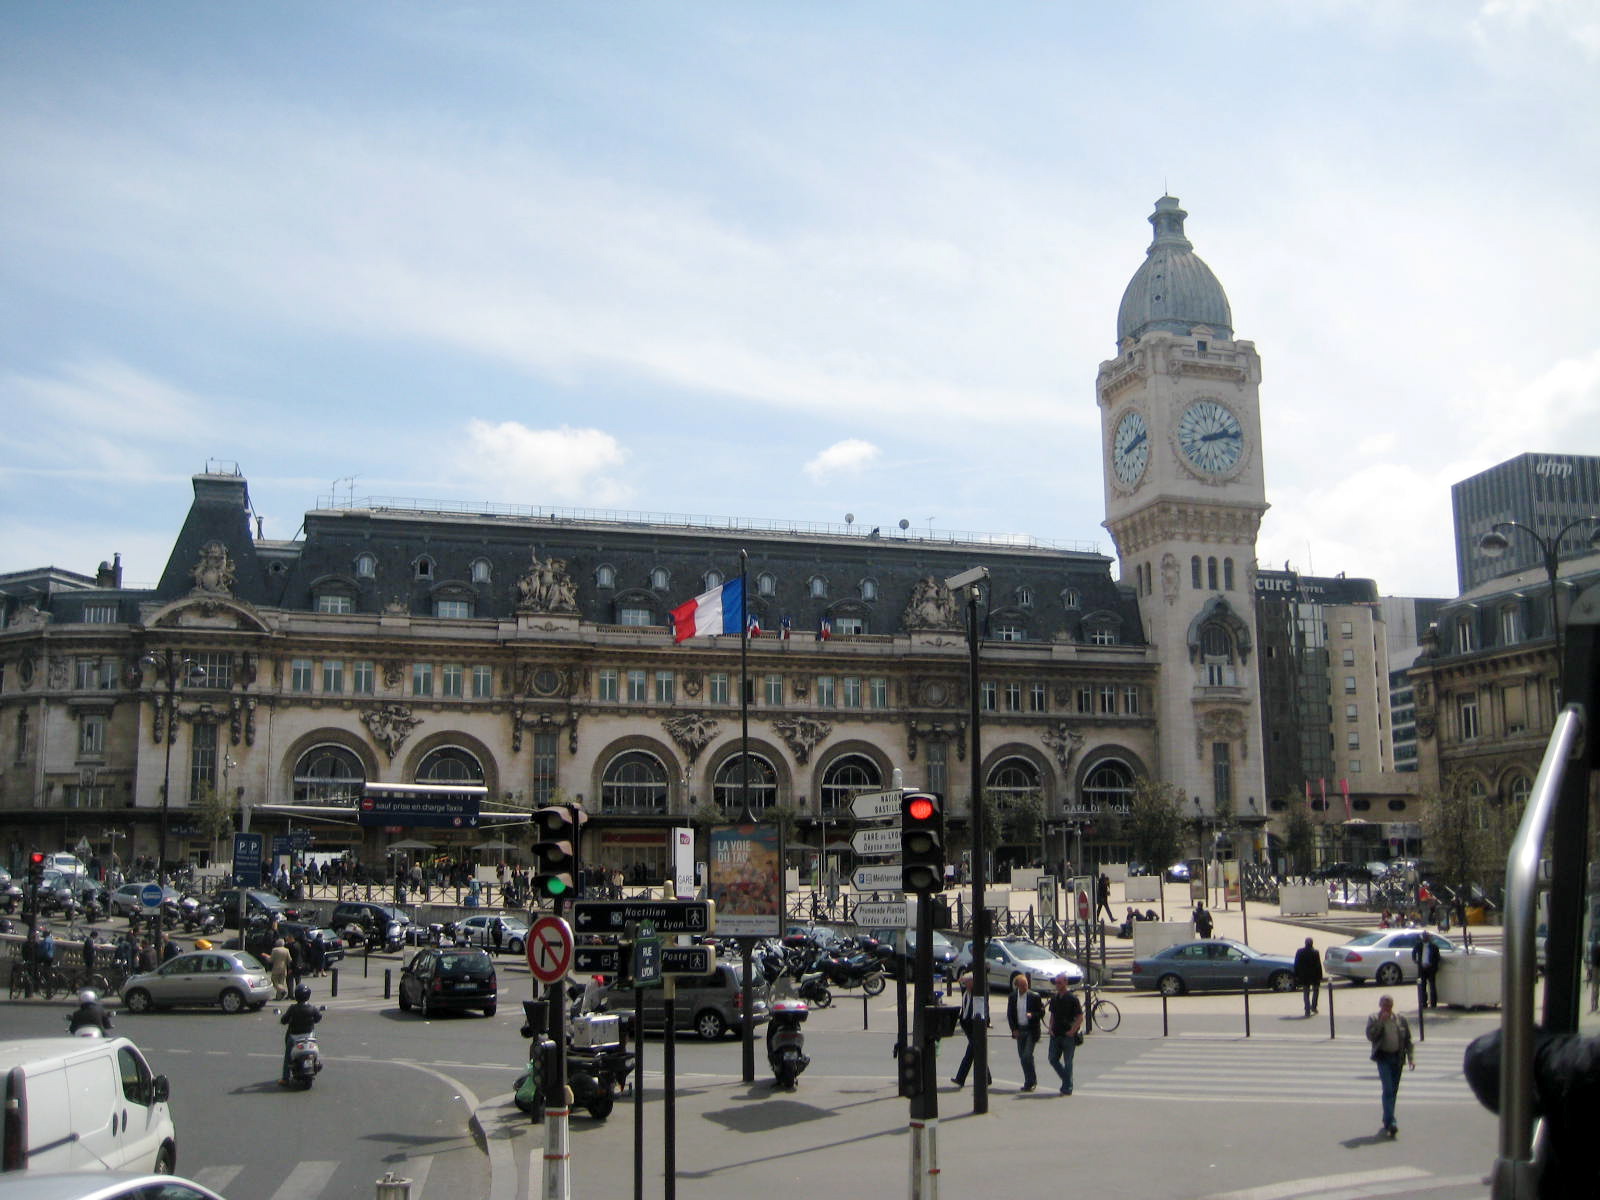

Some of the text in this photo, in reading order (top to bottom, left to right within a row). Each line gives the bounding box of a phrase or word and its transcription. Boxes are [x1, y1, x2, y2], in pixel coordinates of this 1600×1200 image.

[1255, 577, 1325, 593] cure HOTEL
[393, 804, 410, 812] prise
[422, 803, 445, 812] charge
[864, 832, 878, 841] GARE
[717, 840, 751, 851] LA VOIE
[885, 841, 902, 849] minut
[717, 852, 730, 863] DU
[678, 875, 693, 885] GARE
[625, 907, 666, 917] Noctilien
[663, 920, 684, 931] Lyon
[642, 946, 653, 957] RUE
[662, 952, 688, 961] Poste
[641, 966, 654, 978] LYON
